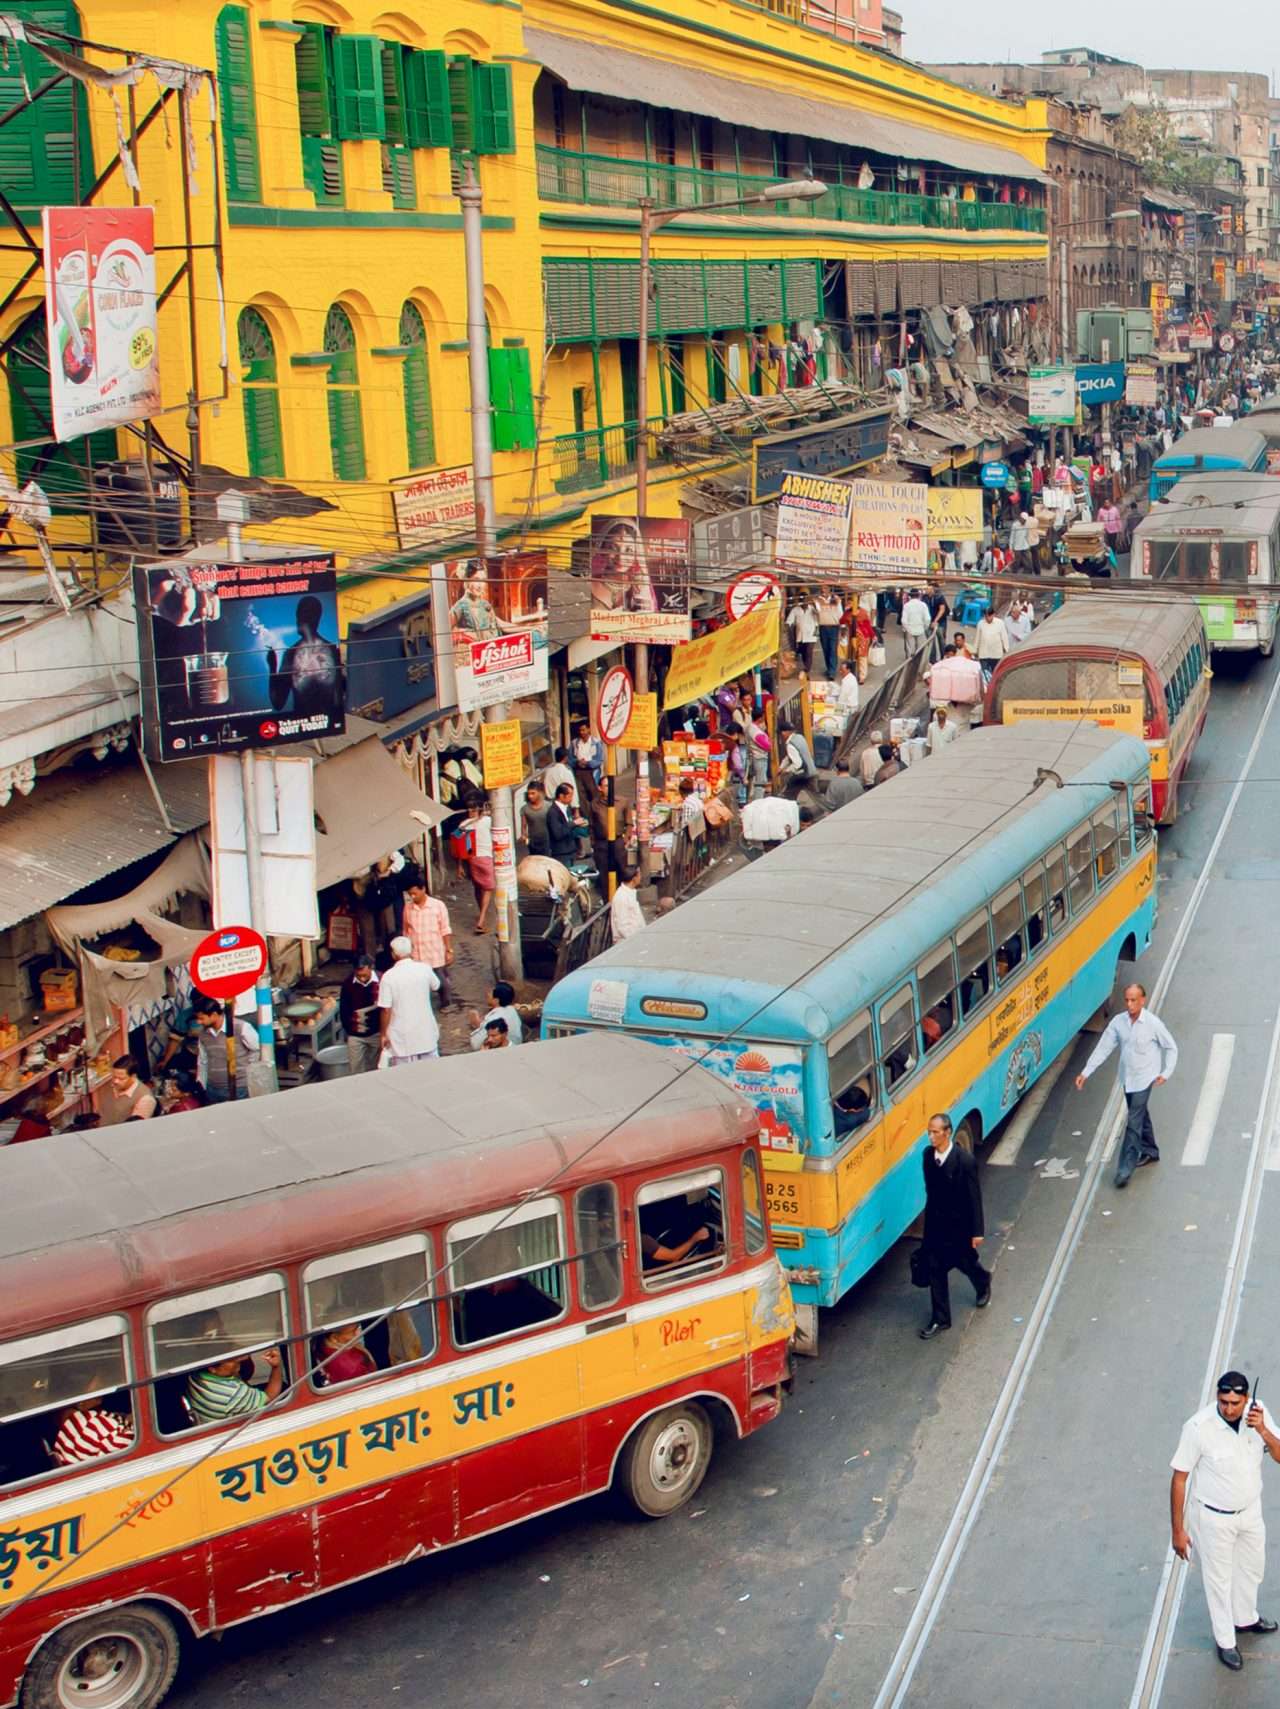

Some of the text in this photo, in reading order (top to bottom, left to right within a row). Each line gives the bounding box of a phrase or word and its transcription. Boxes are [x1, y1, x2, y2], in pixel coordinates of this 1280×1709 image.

[1078, 377, 1116, 391] OKIA
[782, 475, 852, 506] ABHISHEK
[855, 483, 926, 500] ROYAL TOUCH
[439, 501, 475, 521] TRADERS
[857, 530, 921, 552] Raymond
[473, 638, 528, 670] Ashok
[1112, 703, 1131, 715] Sika
[278, 721, 328, 736] QUIT TODAY
[734, 1083, 798, 1096] NJALI GOLD
[215, 1429, 351, 1503] হাওড়া
